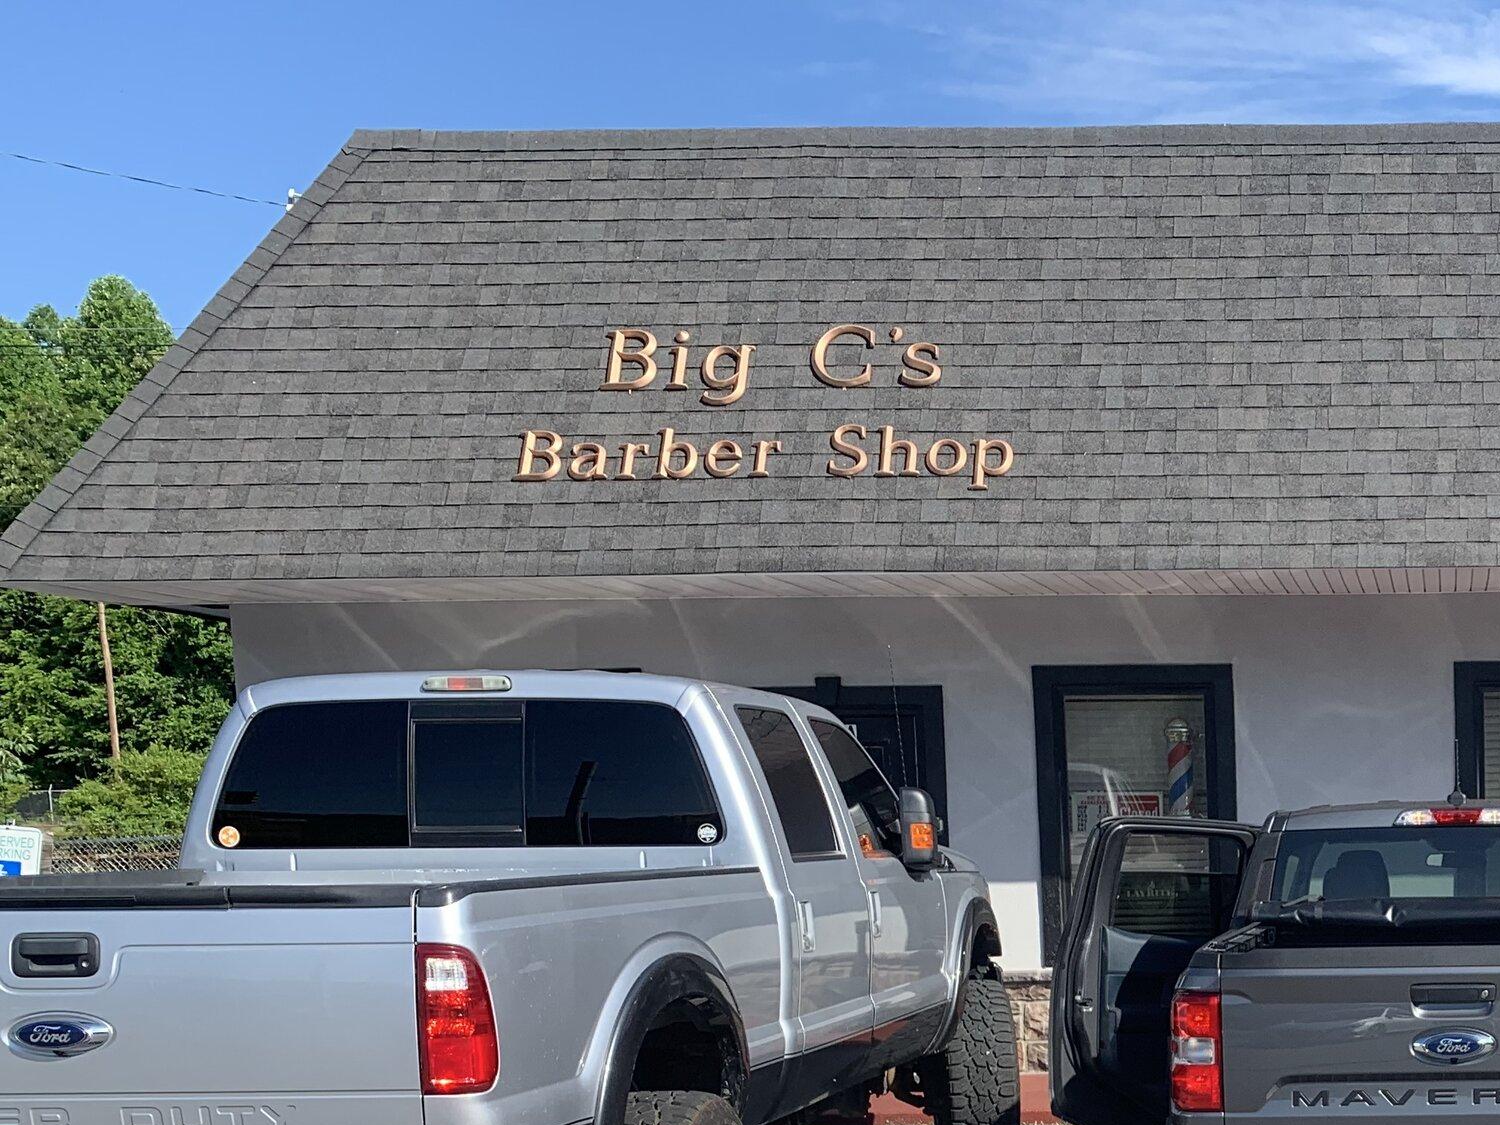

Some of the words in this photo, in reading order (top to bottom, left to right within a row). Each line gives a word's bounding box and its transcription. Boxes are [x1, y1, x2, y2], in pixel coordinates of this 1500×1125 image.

[599, 327, 757, 406] Big
[810, 324, 943, 388] C's
[513, 427, 783, 482] Barber
[827, 422, 1015, 491] Shop
[29, 1024, 72, 1045] Ford
[1436, 1036, 1471, 1055] Ford
